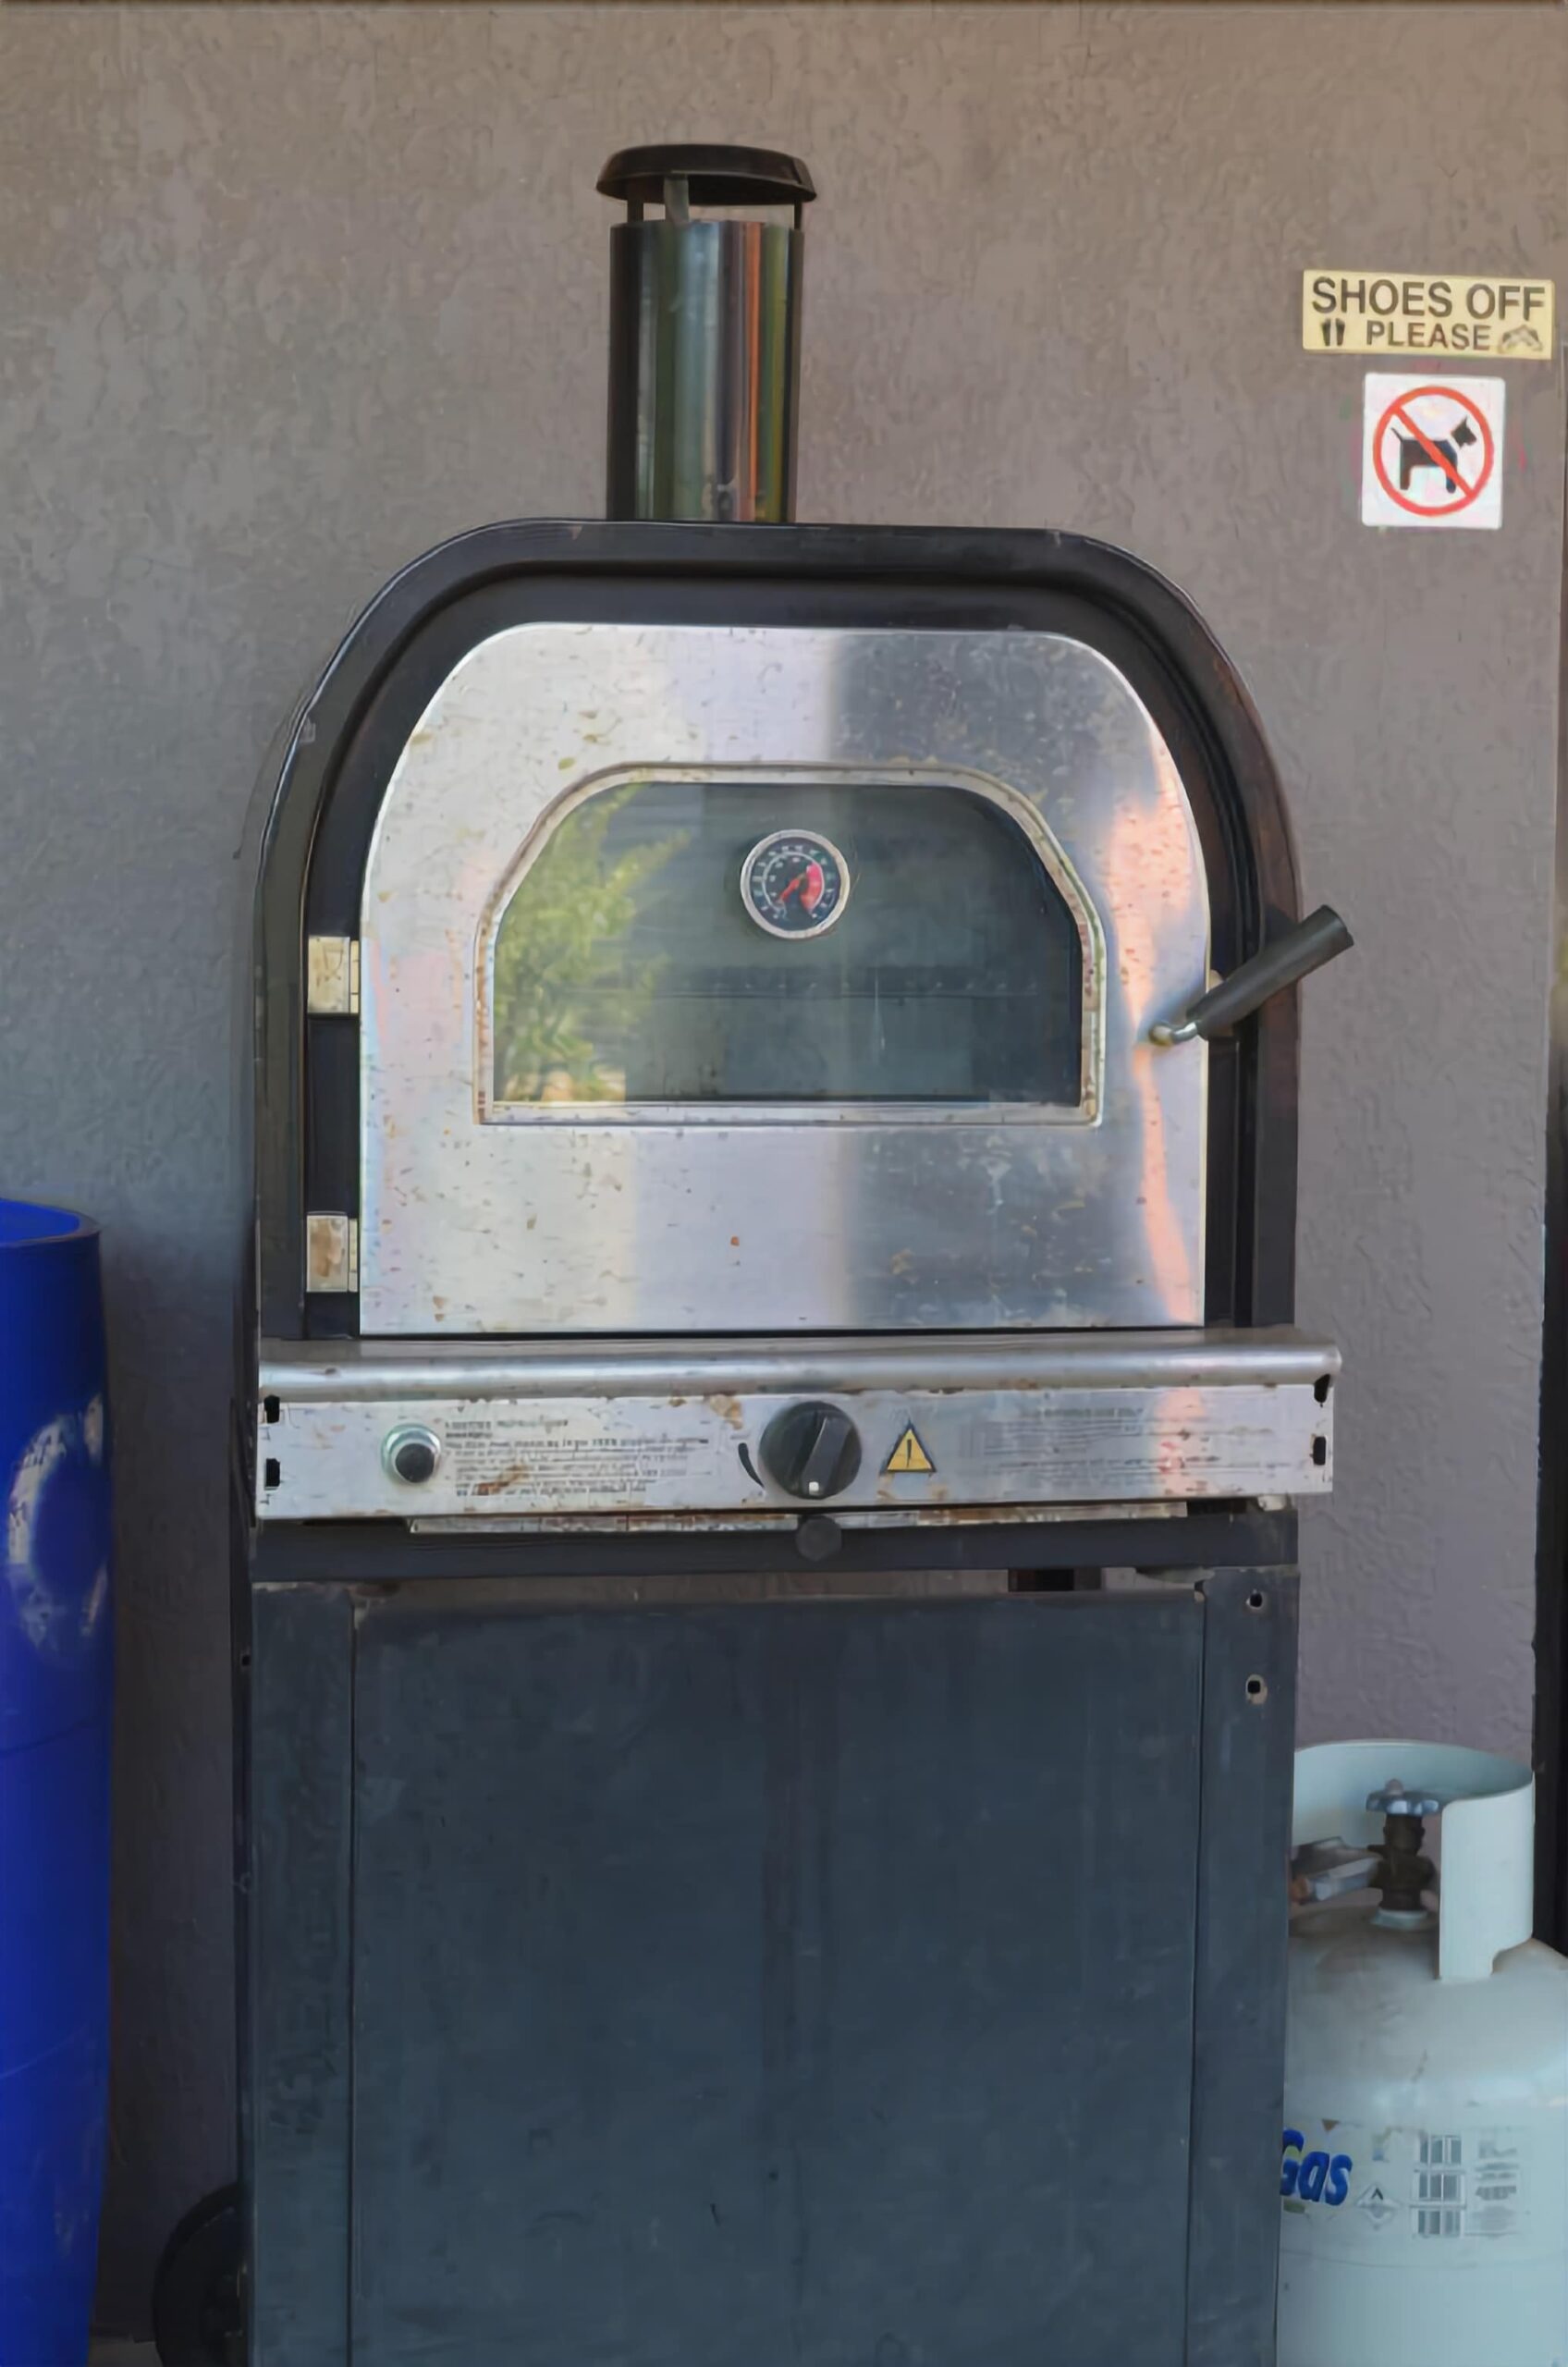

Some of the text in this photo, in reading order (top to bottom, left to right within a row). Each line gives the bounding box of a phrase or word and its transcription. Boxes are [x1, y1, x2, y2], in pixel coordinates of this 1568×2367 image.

[1312, 276, 1545, 321] SHOES OFF
[1366, 320, 1491, 351] PLEASE
